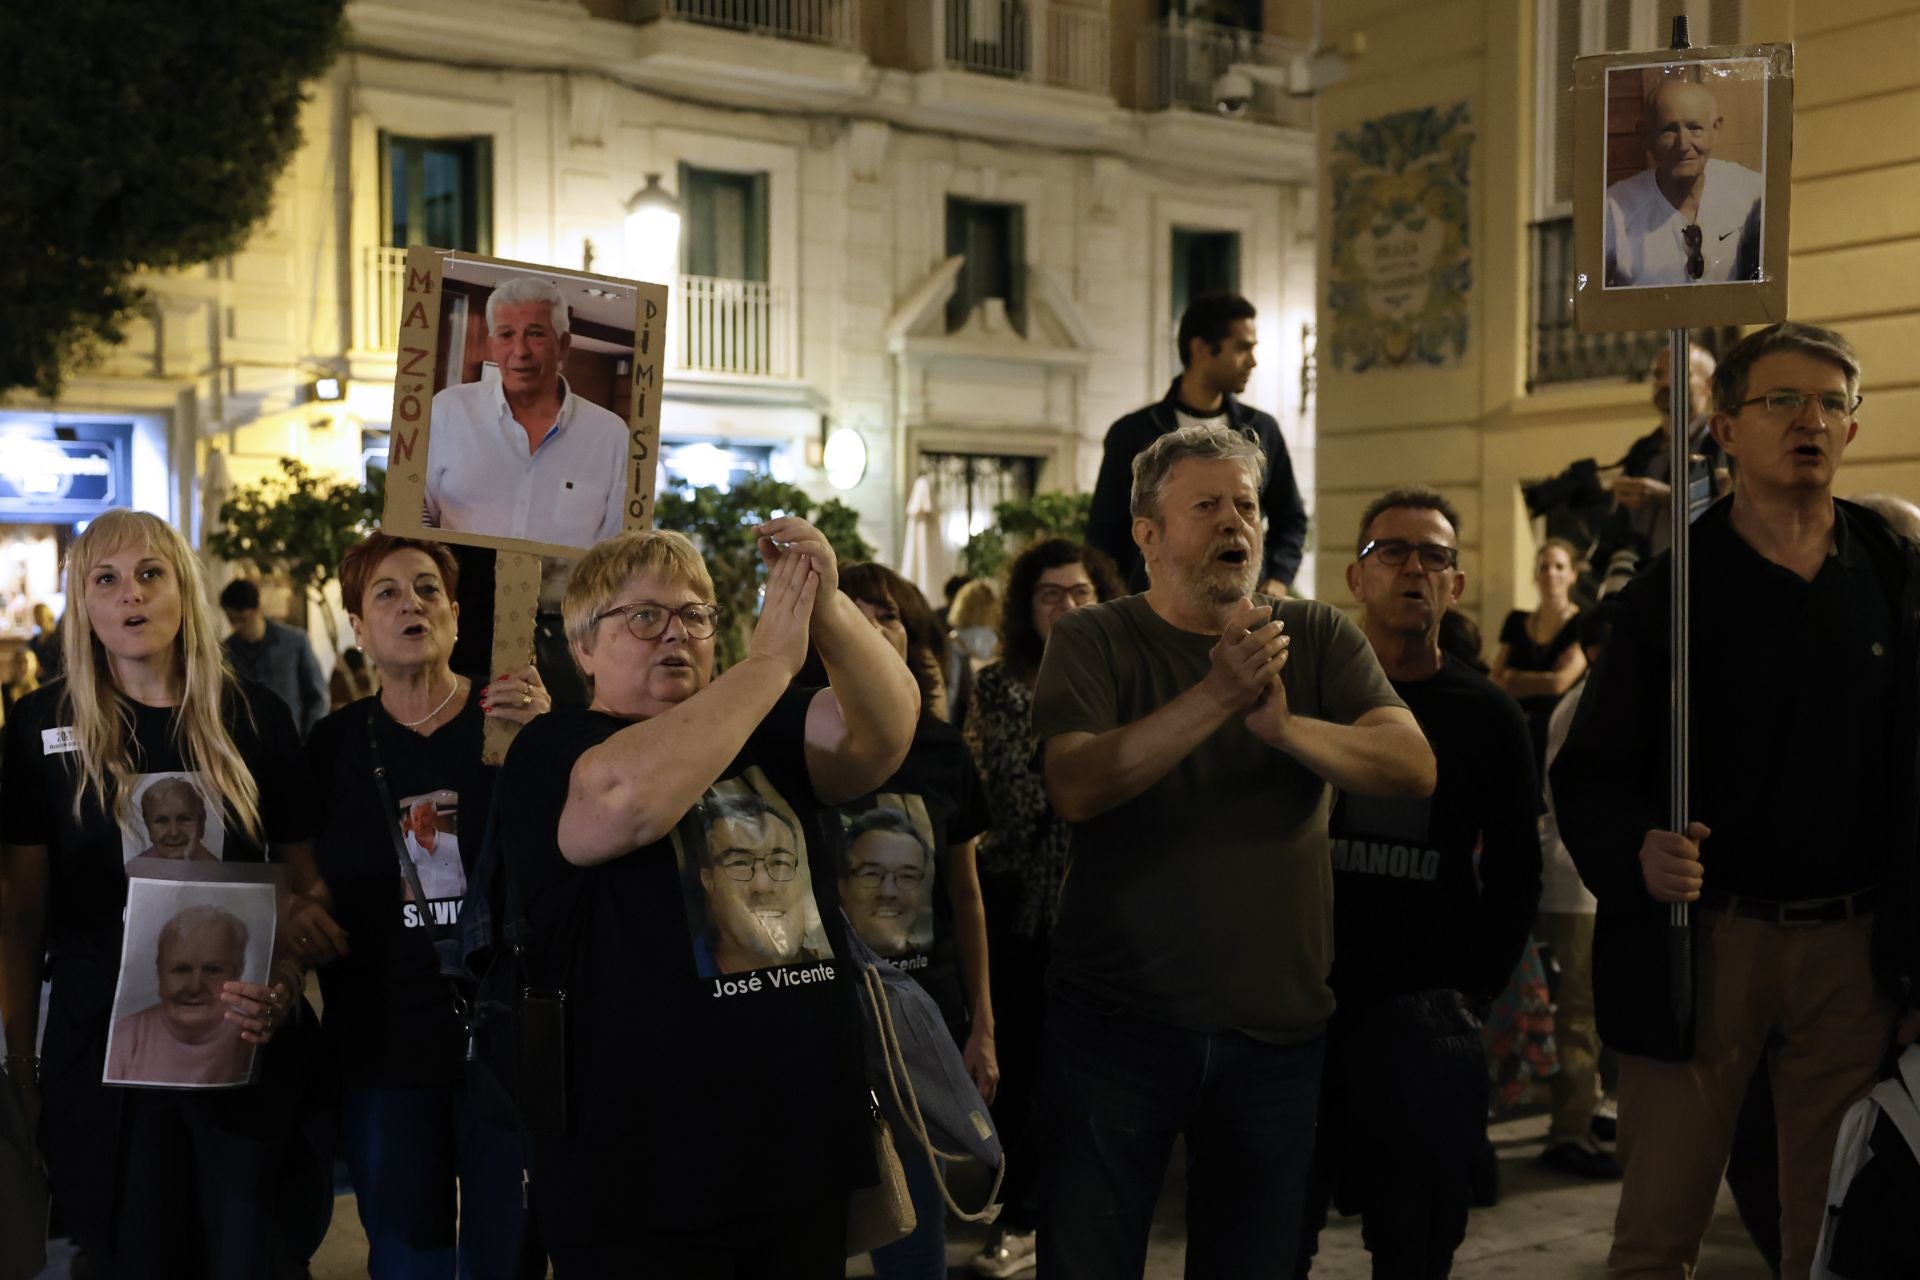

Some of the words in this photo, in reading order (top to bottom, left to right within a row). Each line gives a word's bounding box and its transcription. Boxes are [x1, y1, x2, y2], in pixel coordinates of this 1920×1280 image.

[393, 268, 433, 465] MAZÓN
[712, 973, 763, 998] José
[767, 963, 835, 989] Vicente
